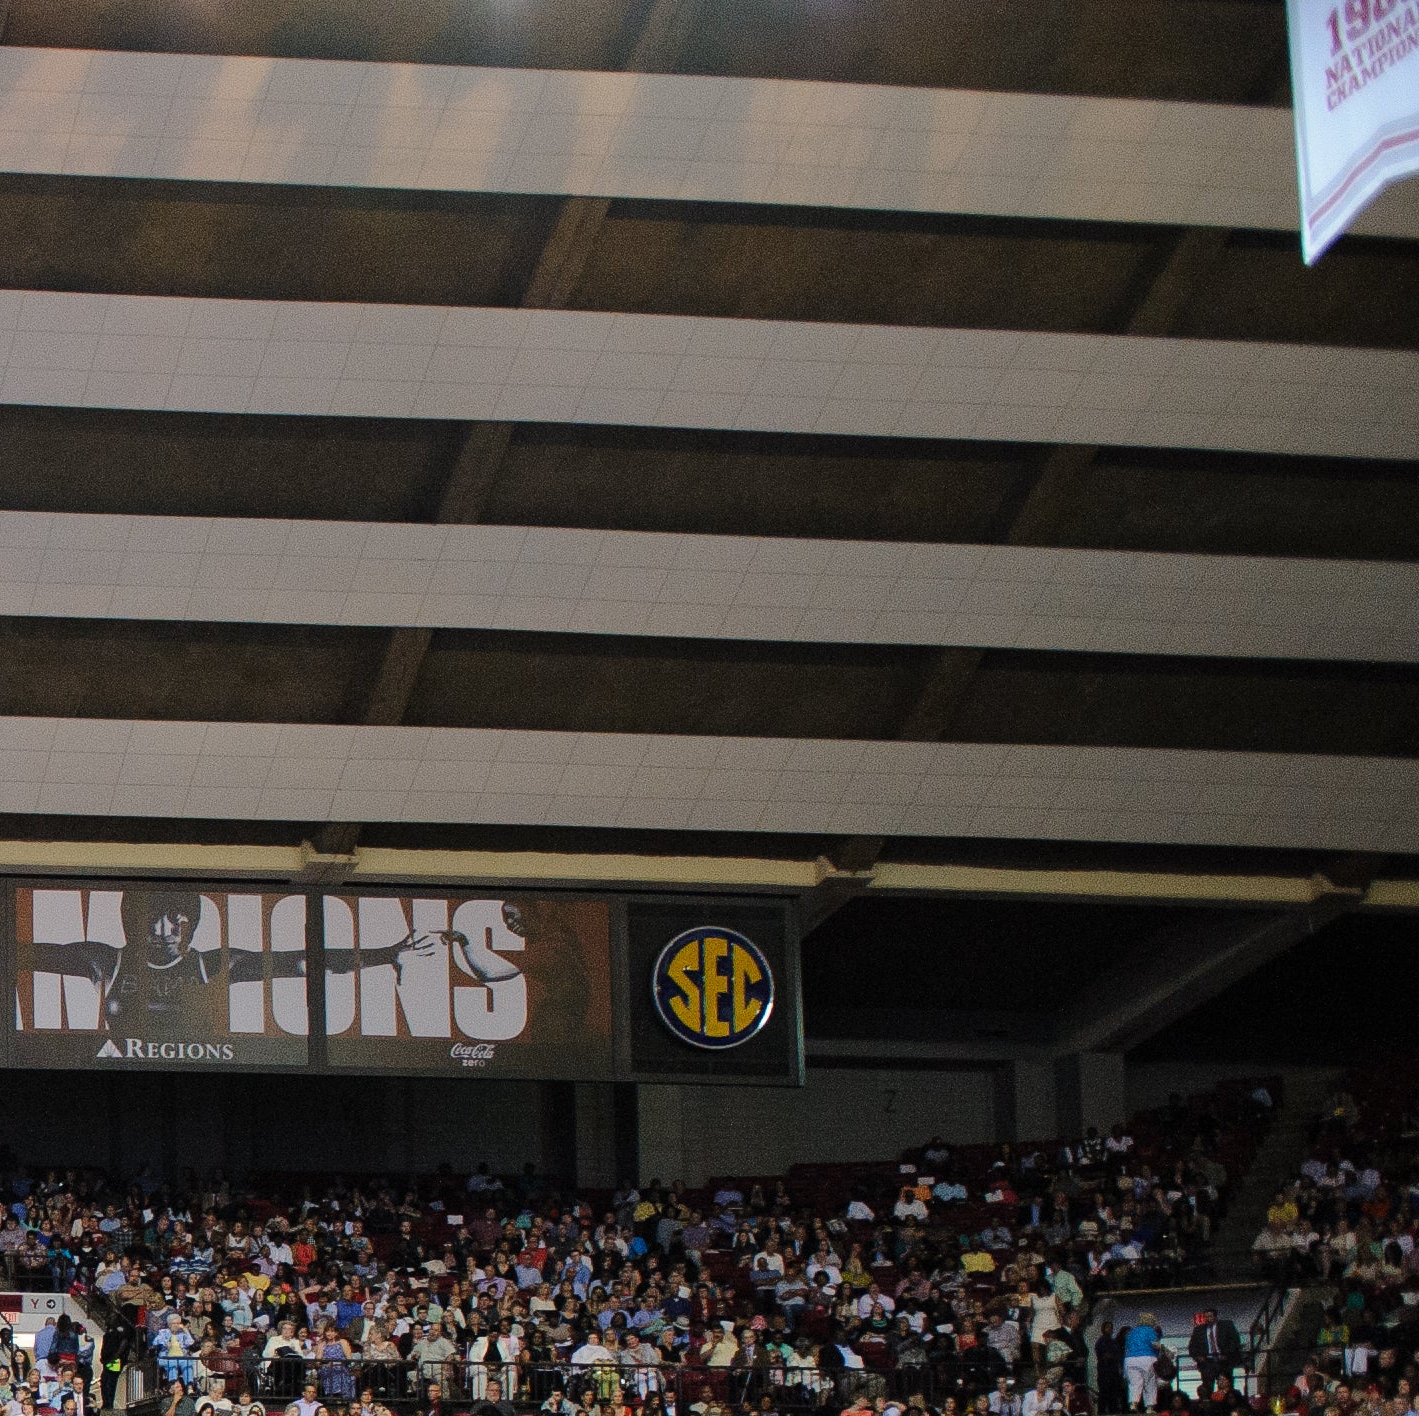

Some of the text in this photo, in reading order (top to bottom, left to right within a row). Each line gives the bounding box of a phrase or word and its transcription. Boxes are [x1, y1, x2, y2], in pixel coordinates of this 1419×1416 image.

[1325, 1, 1419, 90] NATIONA
[667, 936, 763, 1036] SEC
[125, 1038, 234, 1061] REGIONS
[451, 1042, 496, 1059] Coca-Cola
[31, 1298, 39, 1309] Y
